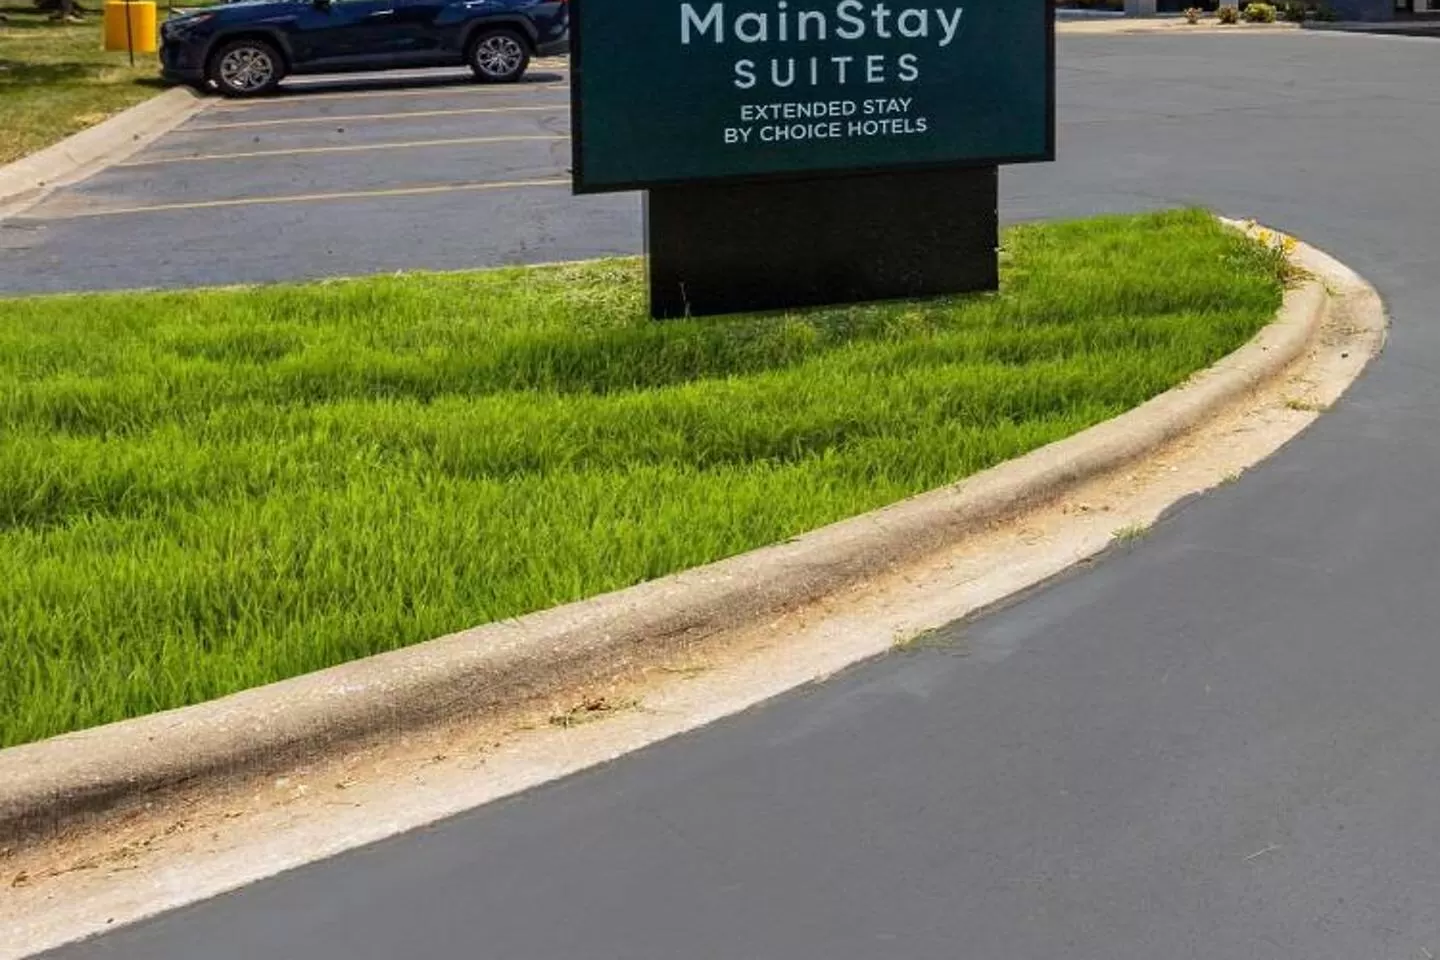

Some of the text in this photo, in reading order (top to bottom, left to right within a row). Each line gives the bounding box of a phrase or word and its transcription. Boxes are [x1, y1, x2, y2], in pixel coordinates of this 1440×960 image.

[680, 0, 963, 46] MainStay
[733, 53, 920, 89] SUITES
[741, 97, 912, 121] EXTENDED STAY
[724, 118, 927, 144] BY CHOICE HOTELS
